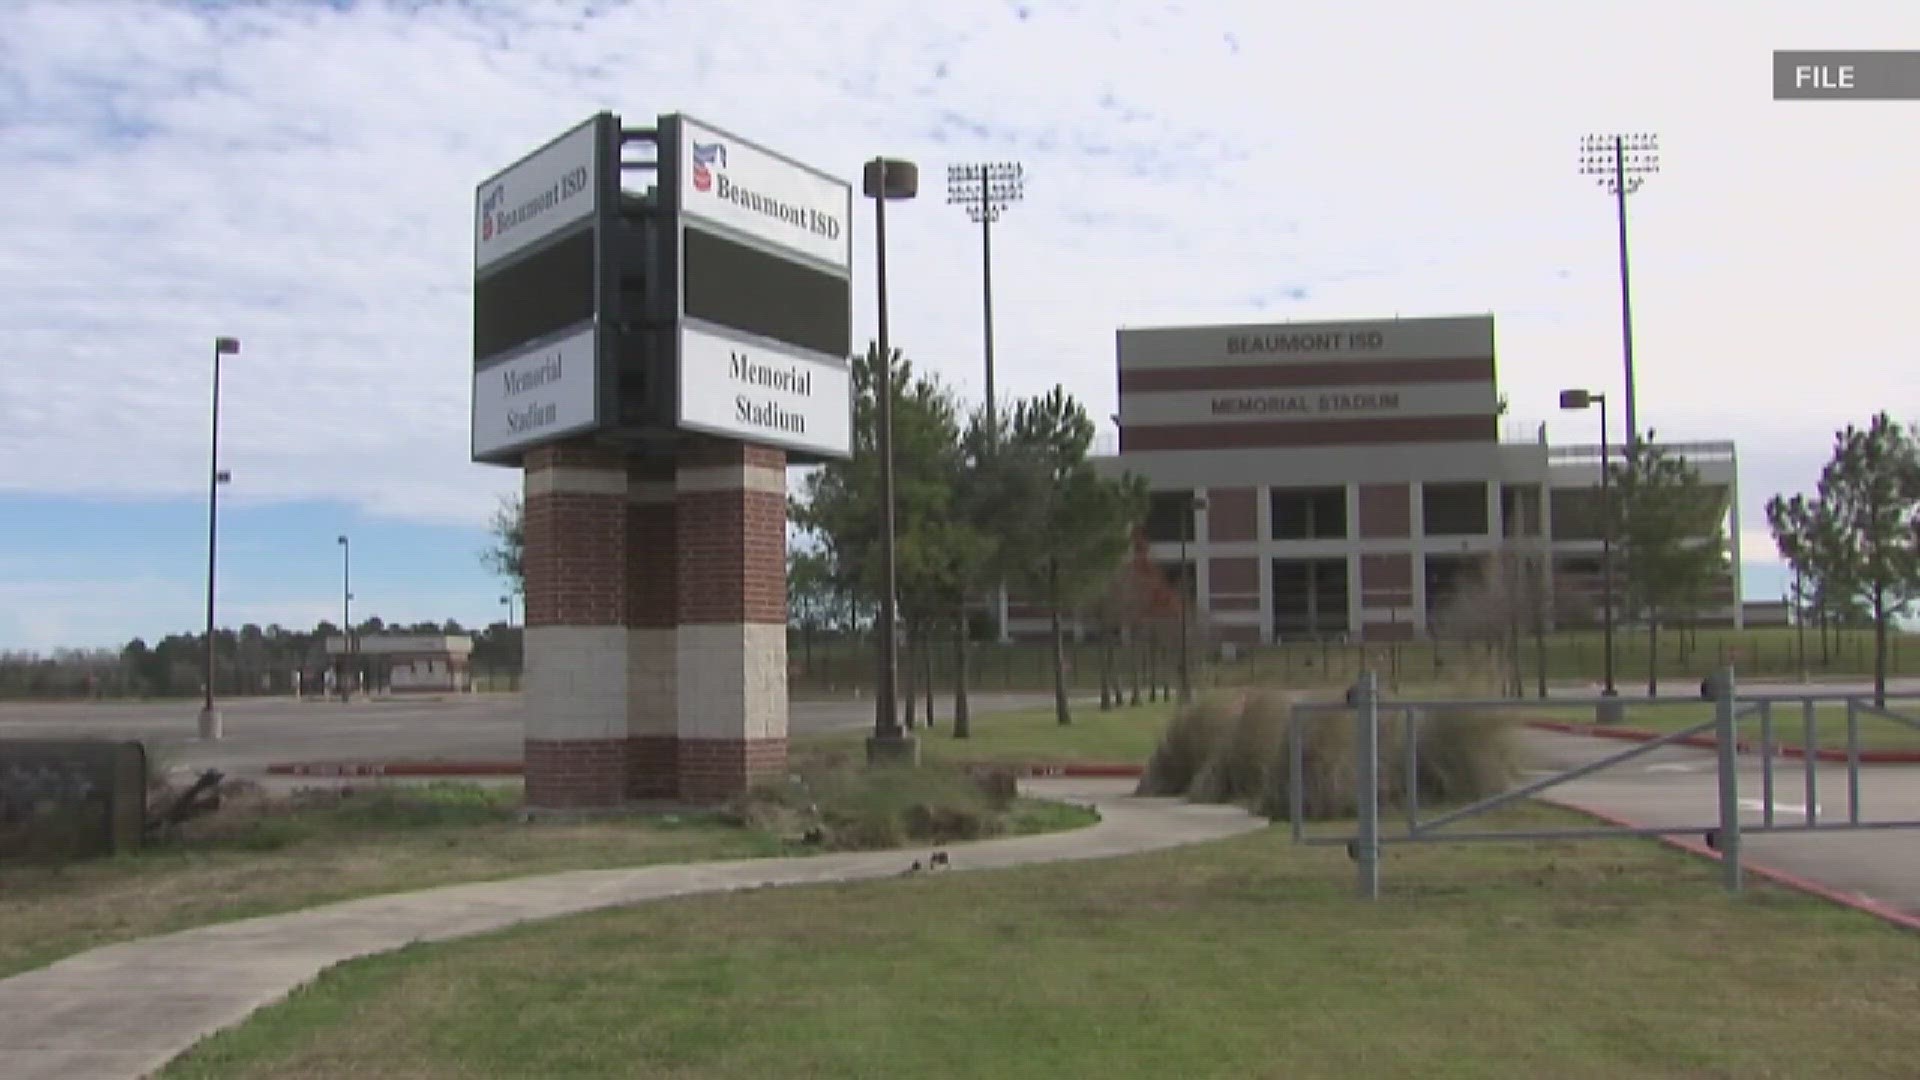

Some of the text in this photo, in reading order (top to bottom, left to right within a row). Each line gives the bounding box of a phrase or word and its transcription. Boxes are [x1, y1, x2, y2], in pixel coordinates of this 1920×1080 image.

[496, 165, 587, 235] Beaumont ISD
[716, 172, 840, 241] Beaumont ISD
[1227, 330, 1383, 355] BEAUMONT ISD
[502, 352, 563, 398] Memorial
[729, 352, 812, 398] Memorial
[506, 399, 558, 436] Stadium
[735, 395, 806, 434] Stadium
[1211, 393, 1400, 416] MEMORIAL STADIUM
